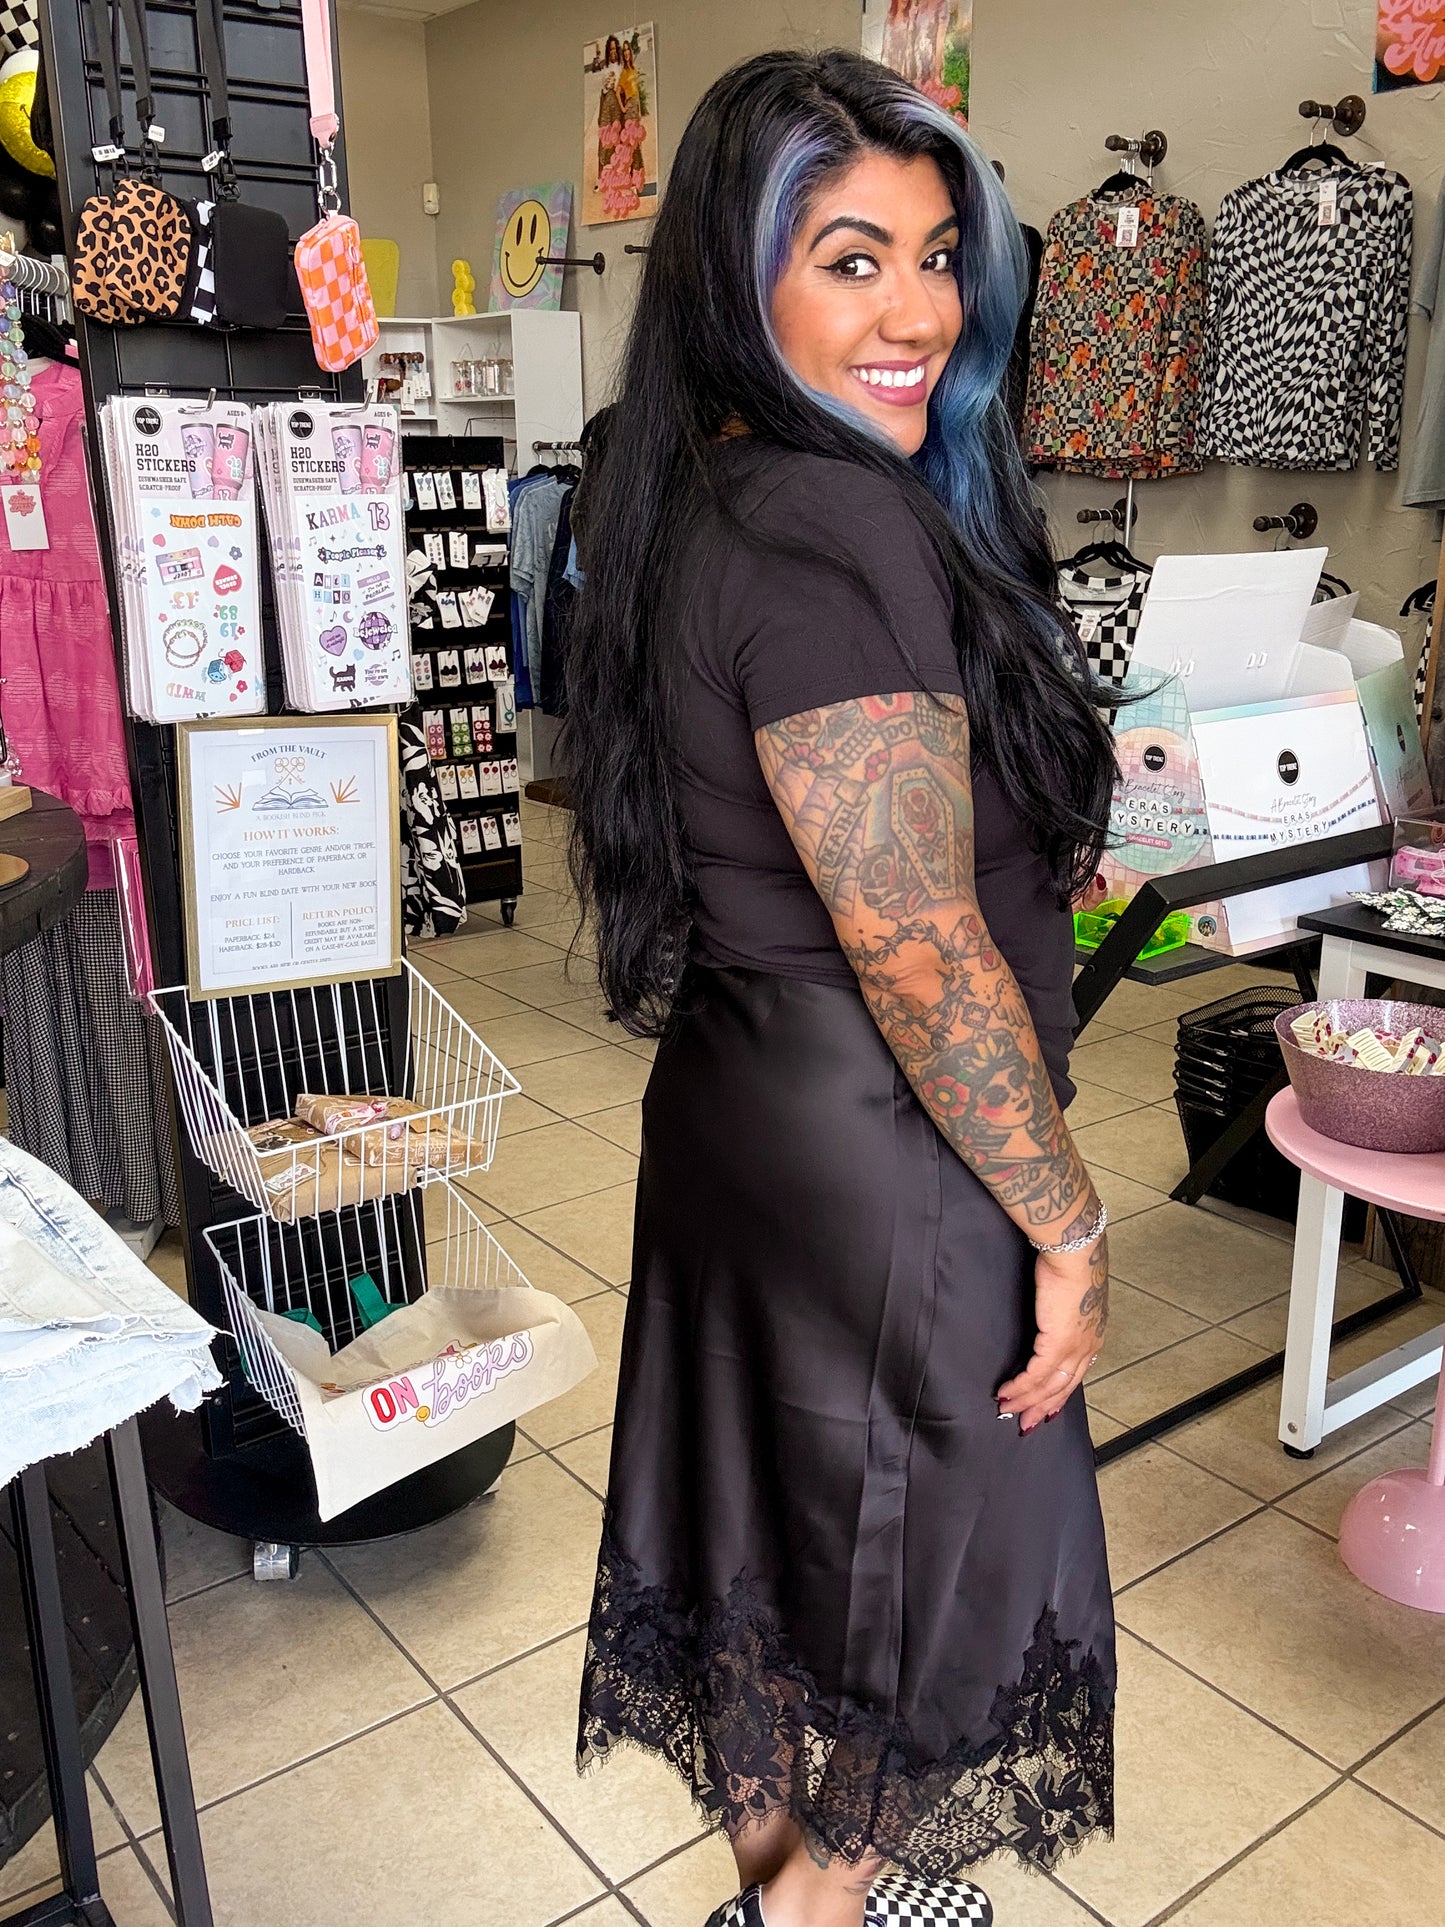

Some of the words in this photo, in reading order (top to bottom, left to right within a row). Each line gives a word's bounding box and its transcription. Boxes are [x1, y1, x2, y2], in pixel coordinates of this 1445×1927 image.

[137, 459, 197, 473] STICKERS
[291, 461, 346, 473] STICKERS
[169, 513, 206, 529] DOWN
[207, 513, 242, 528] CALM
[306, 502, 360, 530] KARMA
[368, 502, 391, 531] 13
[251, 746, 277, 763] FROM
[280, 745, 297, 753] THE
[299, 745, 328, 760] VAULT
[1129, 800, 1169, 814] ERAS
[263, 812, 290, 821] BOOKISH
[1118, 813, 1192, 833] YSTERY
[1283, 811, 1311, 824] ERAS
[243, 829, 275, 842] HOW
[277, 829, 291, 839] IT
[293, 826, 340, 838] WORKS:
[1270, 821, 1327, 842] MYSTERY
[212, 851, 241, 860] CHOOSE
[244, 850, 263, 858] YOUR
[265, 847, 299, 857] FAVORITE
[300, 846, 322, 854] GENRE
[325, 843, 351, 852] AND/OR
[223, 862, 239, 870] AND
[240, 860, 260, 868] YOUR
[262, 856, 304, 867] PREFERENCE
[317, 853, 355, 863] PAPERBACK
[278, 866, 315, 876] HARDBACK
[210, 893, 232, 902] ENJOY
[243, 891, 257, 899] FUN
[259, 888, 280, 898] BLIND
[281, 887, 299, 896] DATE
[301, 885, 320, 893] WITH
[322, 883, 340, 891] YOUR
[342, 881, 357, 890] NEW
[360, 880, 377, 888] BOOK
[302, 909, 340, 920] RETURN
[225, 918, 253, 929] PRICE
[317, 921, 336, 929] BOOKS
[303, 937, 323, 945] CREDIT
[347, 931, 376, 940] AVAILABLE
[305, 929, 338, 937] REFUNDABLE
[370, 1376, 420, 1424] ON
[422, 1333, 528, 1420] books
